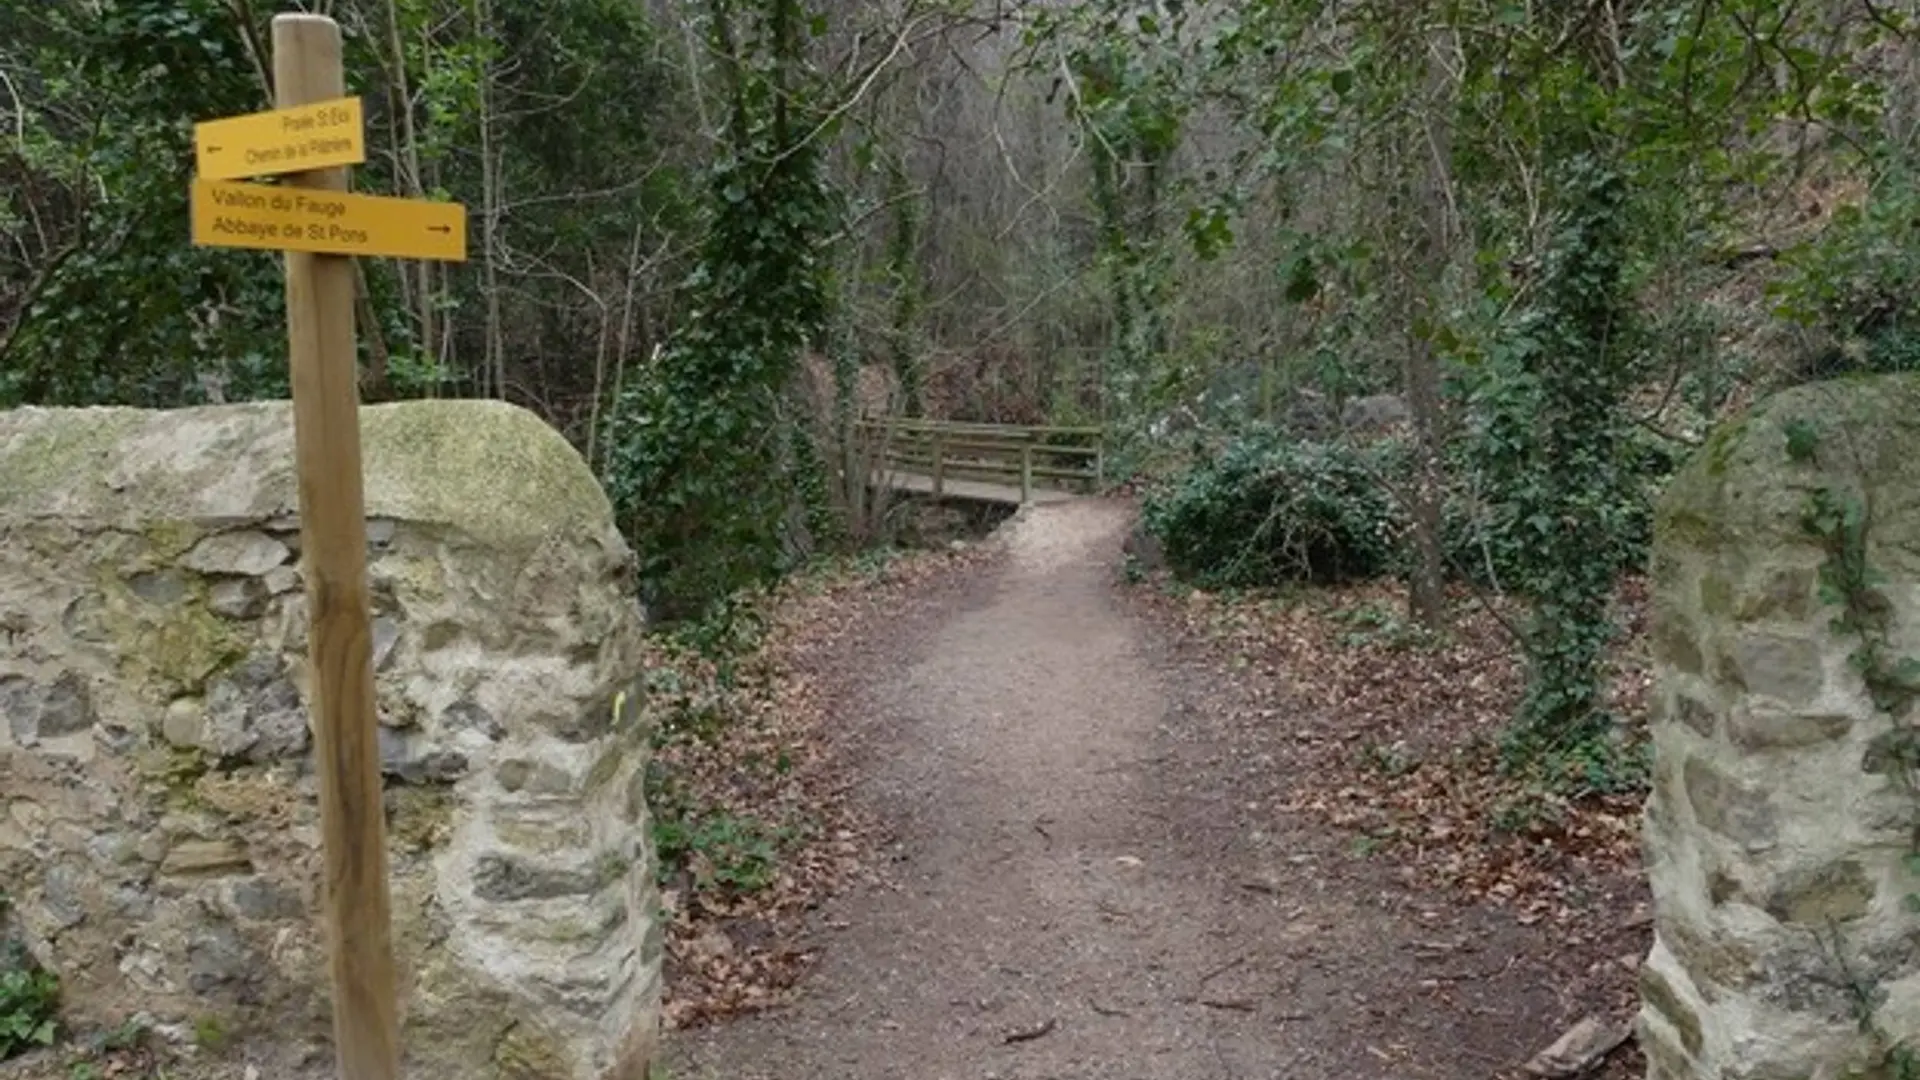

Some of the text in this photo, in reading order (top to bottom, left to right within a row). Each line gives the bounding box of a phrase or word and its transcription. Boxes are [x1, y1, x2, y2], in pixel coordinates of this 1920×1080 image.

[212, 188, 347, 218] Vallon du Fauge
[212, 216, 368, 243] Abbaye de St Pons
